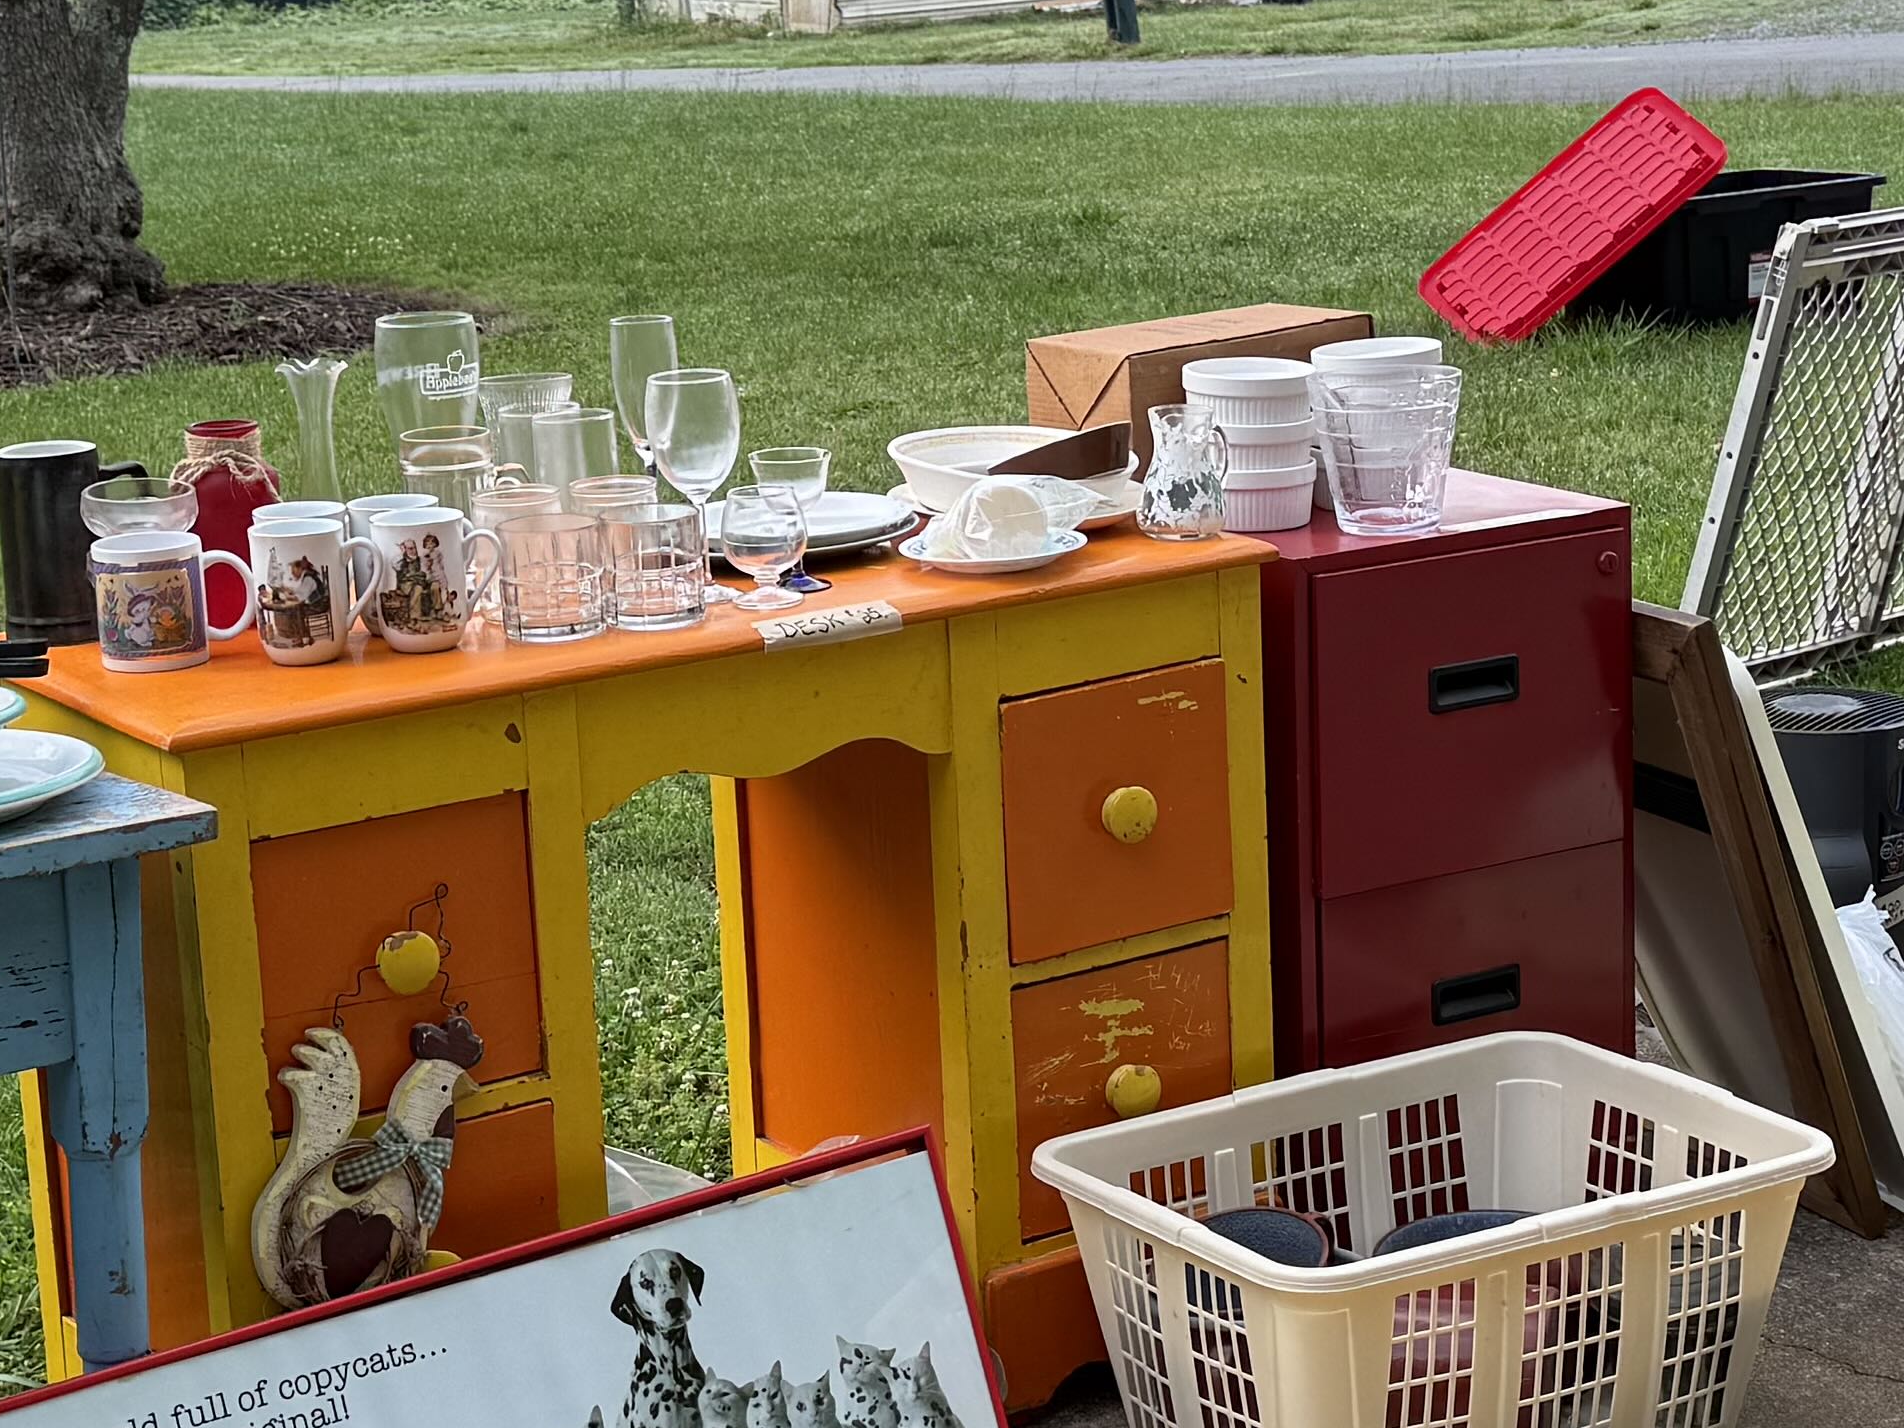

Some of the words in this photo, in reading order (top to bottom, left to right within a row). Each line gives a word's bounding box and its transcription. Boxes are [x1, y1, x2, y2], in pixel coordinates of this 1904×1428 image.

[775, 613, 845, 638] DESK
[238, 1378, 271, 1412] of
[277, 1340, 448, 1401] copycats...
